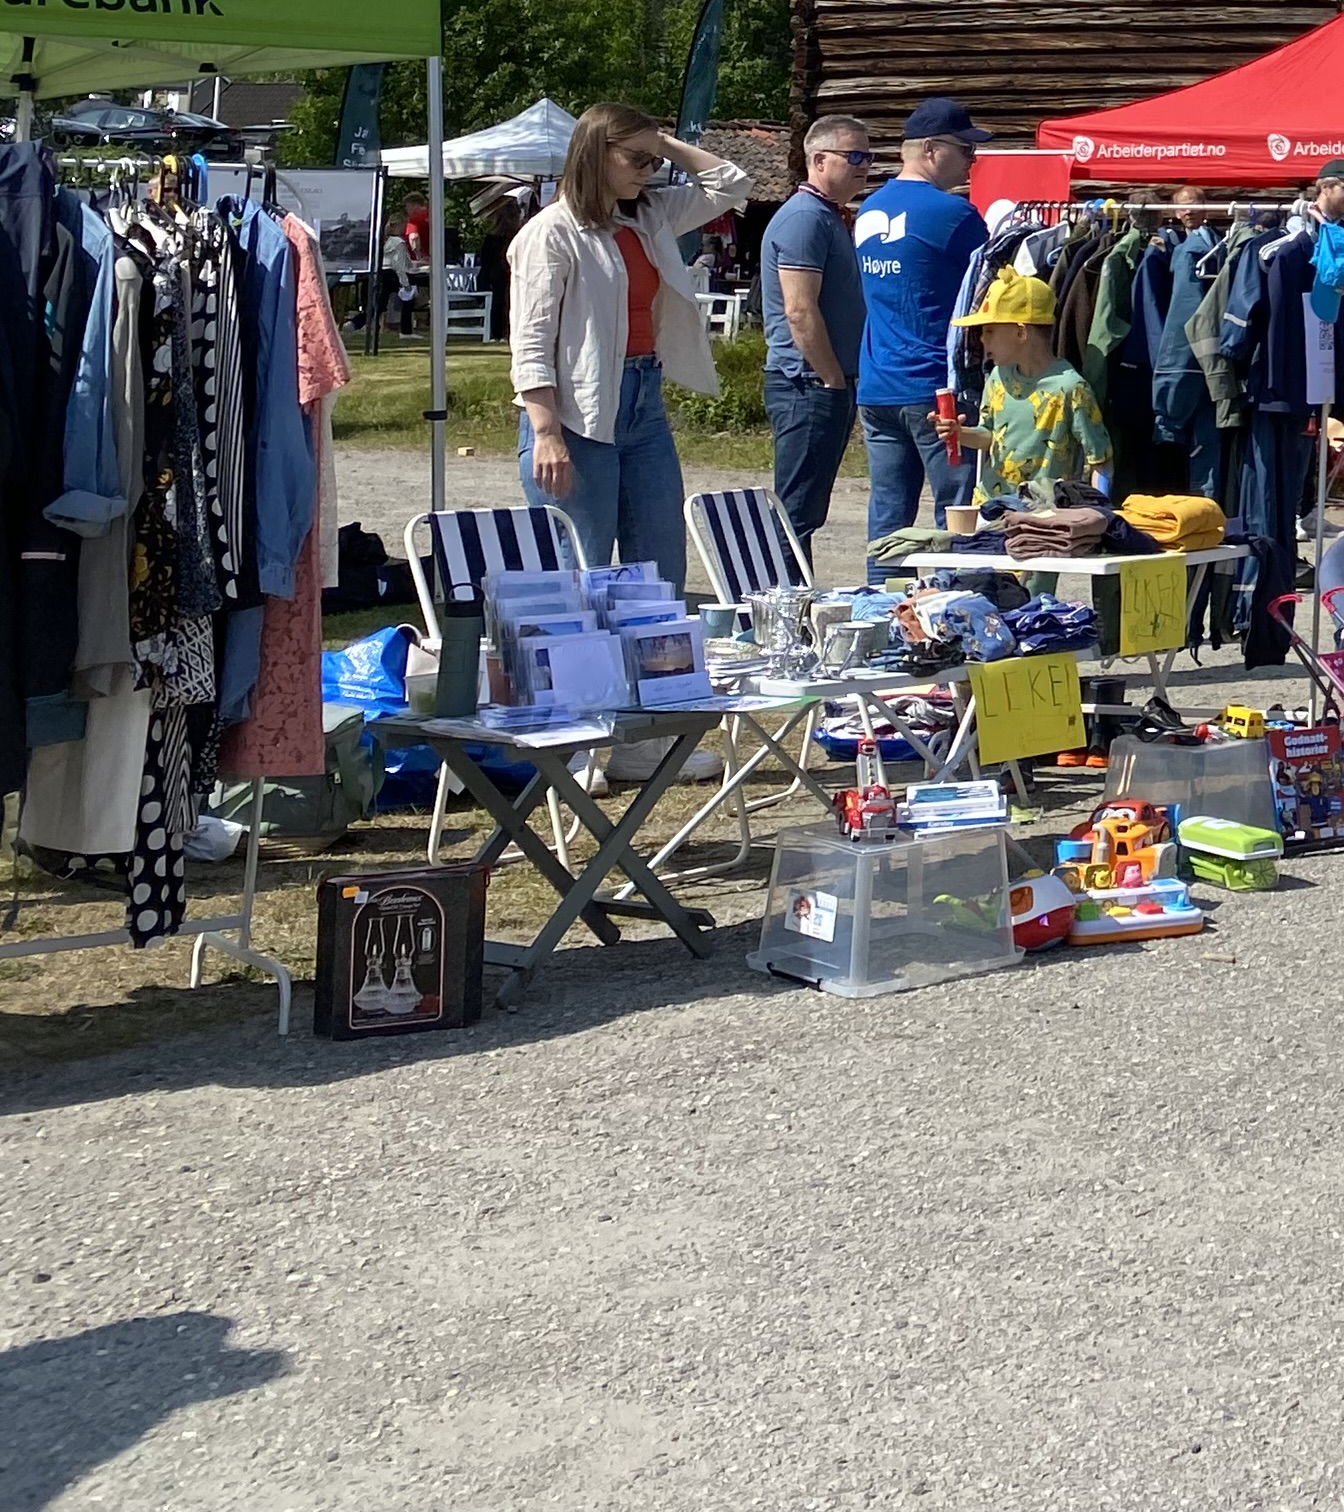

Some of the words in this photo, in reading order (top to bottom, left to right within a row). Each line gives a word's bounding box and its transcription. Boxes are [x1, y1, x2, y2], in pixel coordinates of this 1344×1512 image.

[1096, 142, 1226, 159] Arbeiderpartiet.no
[862, 255, 902, 278] Høyre
[1284, 733, 1328, 746] Godnatt-
[1286, 746, 1329, 758] historier
